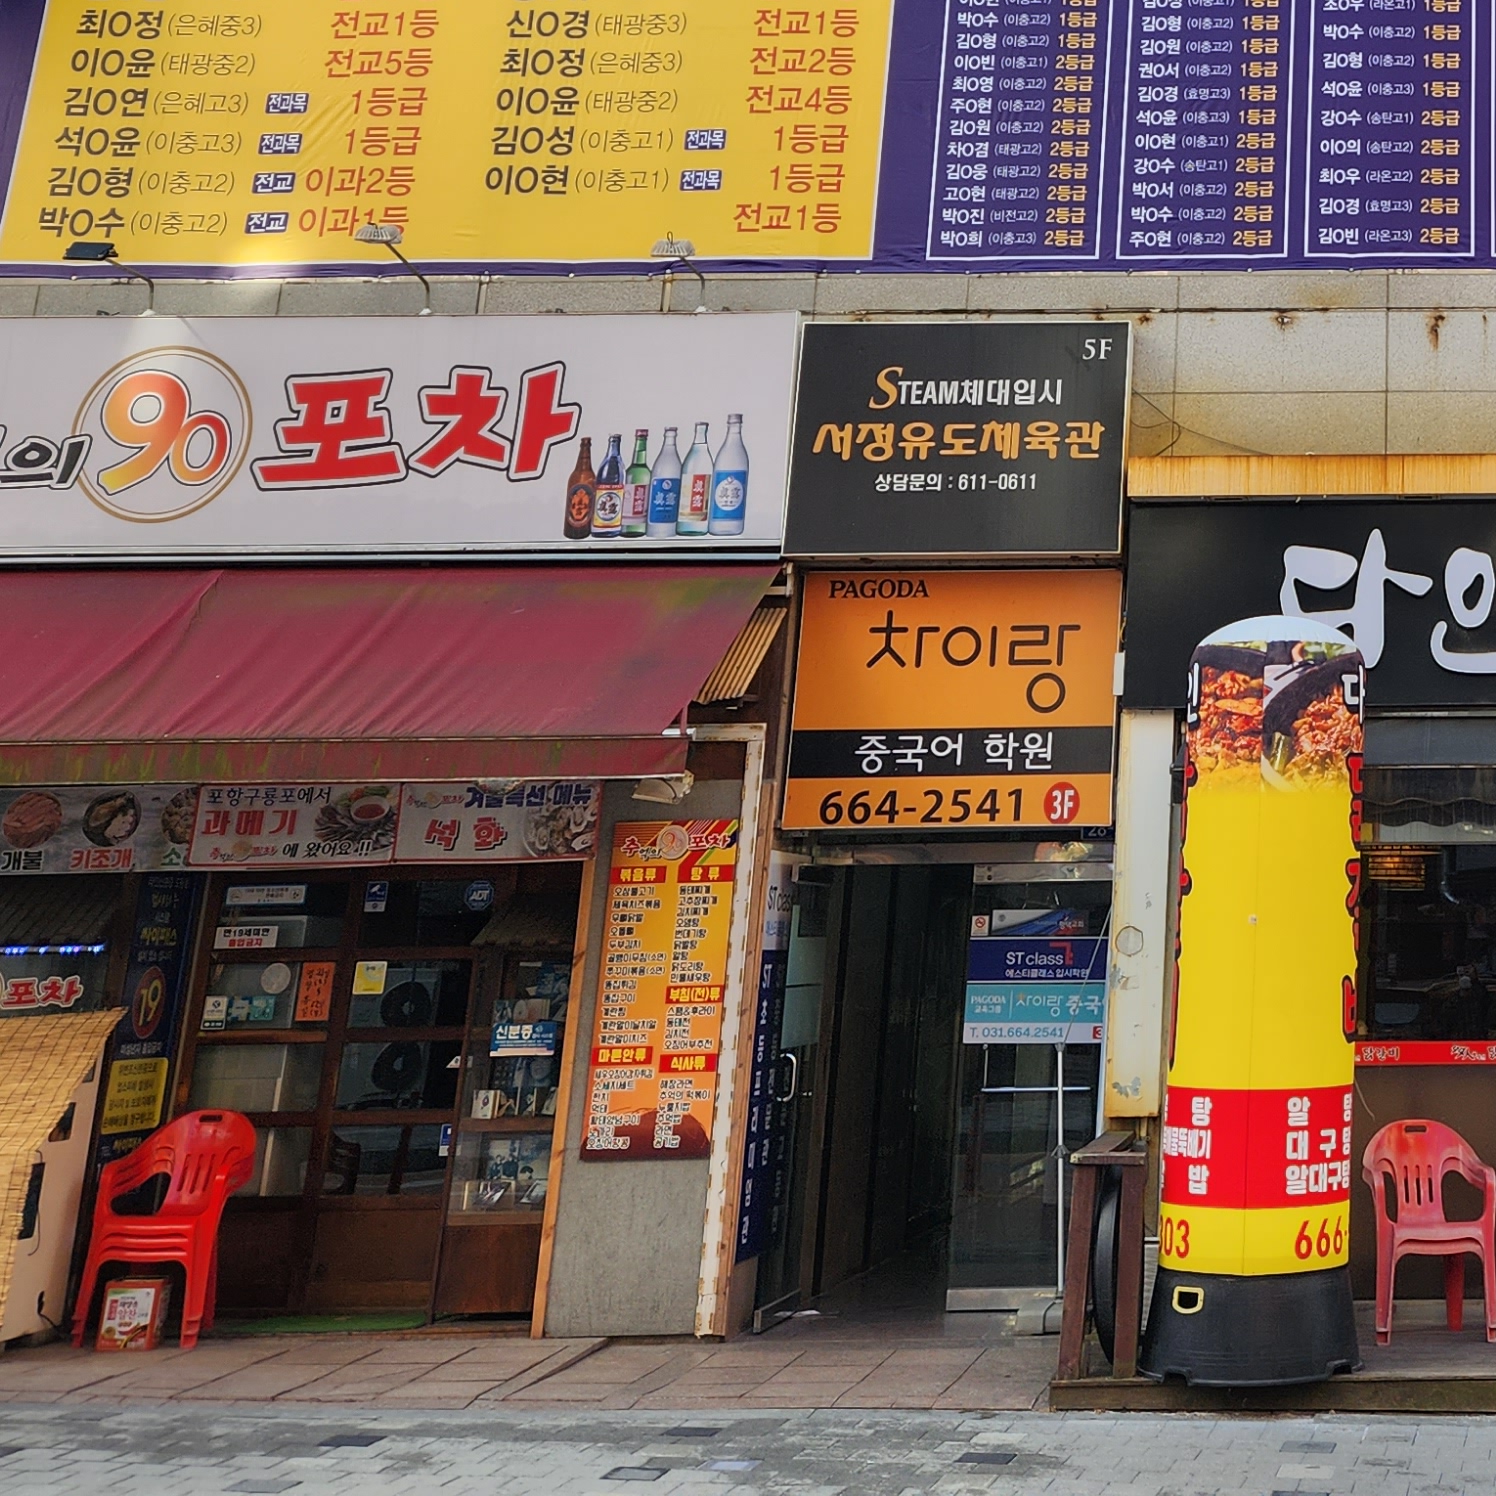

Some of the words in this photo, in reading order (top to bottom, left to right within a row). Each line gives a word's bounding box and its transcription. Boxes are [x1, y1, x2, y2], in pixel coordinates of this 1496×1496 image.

[331, 10, 439, 39] 전교1등
[754, 8, 859, 37] 전교1등
[325, 48, 434, 78] 전교5등
[749, 46, 857, 76] 전교2등
[267, 94, 308, 112] 전과목
[351, 87, 428, 117] 1등급
[746, 85, 852, 114] 전교4등
[260, 135, 301, 152] 전과목
[345, 126, 422, 156] 1등급
[686, 130, 725, 149] 전과목
[773, 124, 849, 155] 1등급
[305, 165, 415, 197] 이과2등
[682, 171, 720, 190] 전과목
[769, 164, 845, 193] 1등급
[733, 203, 842, 233] 전교1등
[1082, 338, 1112, 360] 5F
[868, 366, 1063, 410] STEAM체대입시
[98, 368, 232, 495] 90
[250, 361, 582, 492] 포차
[812, 420, 1106, 462] 서정유도체육관
[874, 473, 942, 493] 상담문의
[958, 473, 1037, 491] 611-0611
[829, 578, 929, 599] PAGODA
[866, 609, 1082, 714] 차이랑
[854, 733, 964, 775] 중국어
[983, 731, 1053, 770] 학원
[207, 786, 331, 804] 포항구룡포에서
[818, 788, 1024, 825] 664-2541
[1050, 790, 1075, 820] 3F
[201, 810, 298, 837] 과메기
[1, 850, 44, 870] 개불
[71, 849, 132, 870] 키조개
[304, 841, 355, 859] 왔어요
[2, 977, 84, 1007] 포차
[139, 981, 161, 1021] 19
[971, 995, 1006, 1004] PAGODA
[1016, 992, 1063, 1017] 차이랑
[496, 1024, 532, 1039] 신분증
[982, 1027, 1064, 1038] 031.664.2541
